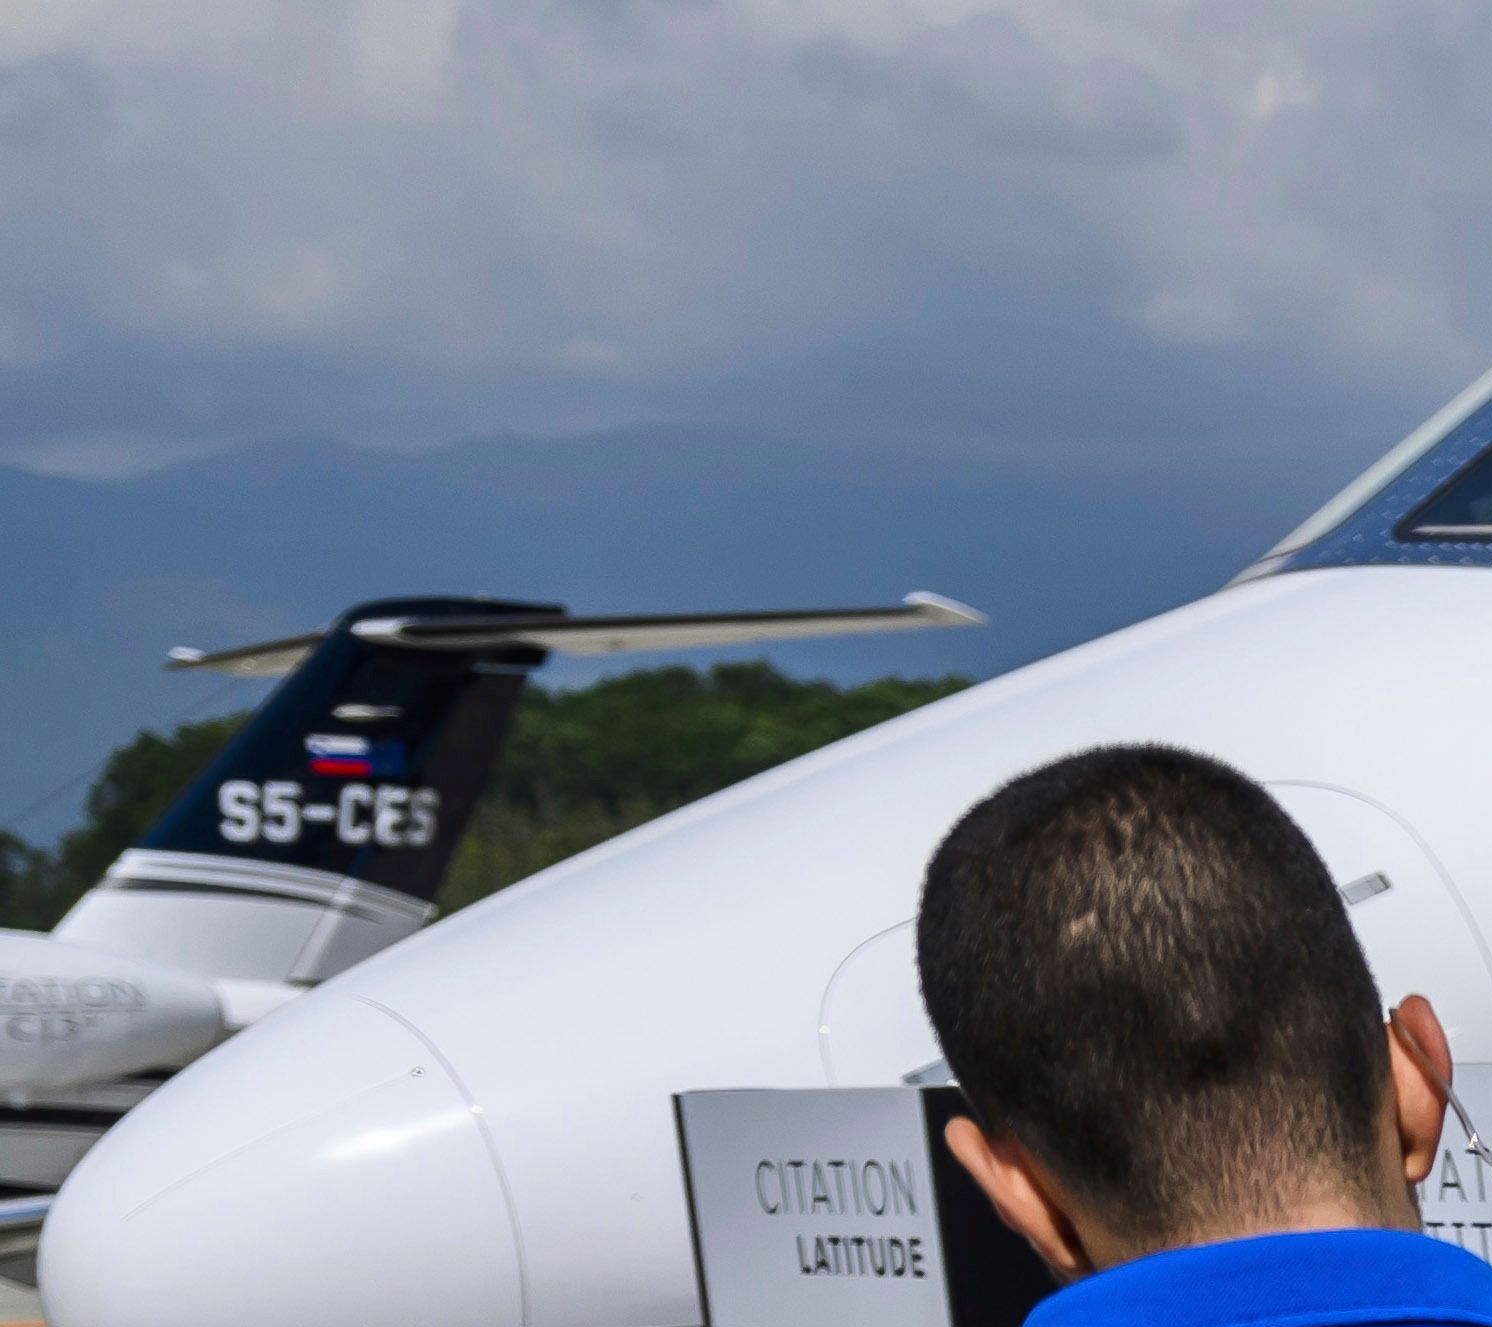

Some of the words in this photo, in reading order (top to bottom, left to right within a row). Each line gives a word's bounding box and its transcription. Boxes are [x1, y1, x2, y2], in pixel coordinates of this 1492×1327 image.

[218, 780, 439, 845] S5-CES
[755, 1159, 918, 1217] CITATION
[796, 1233, 927, 1278] LATITUDE
